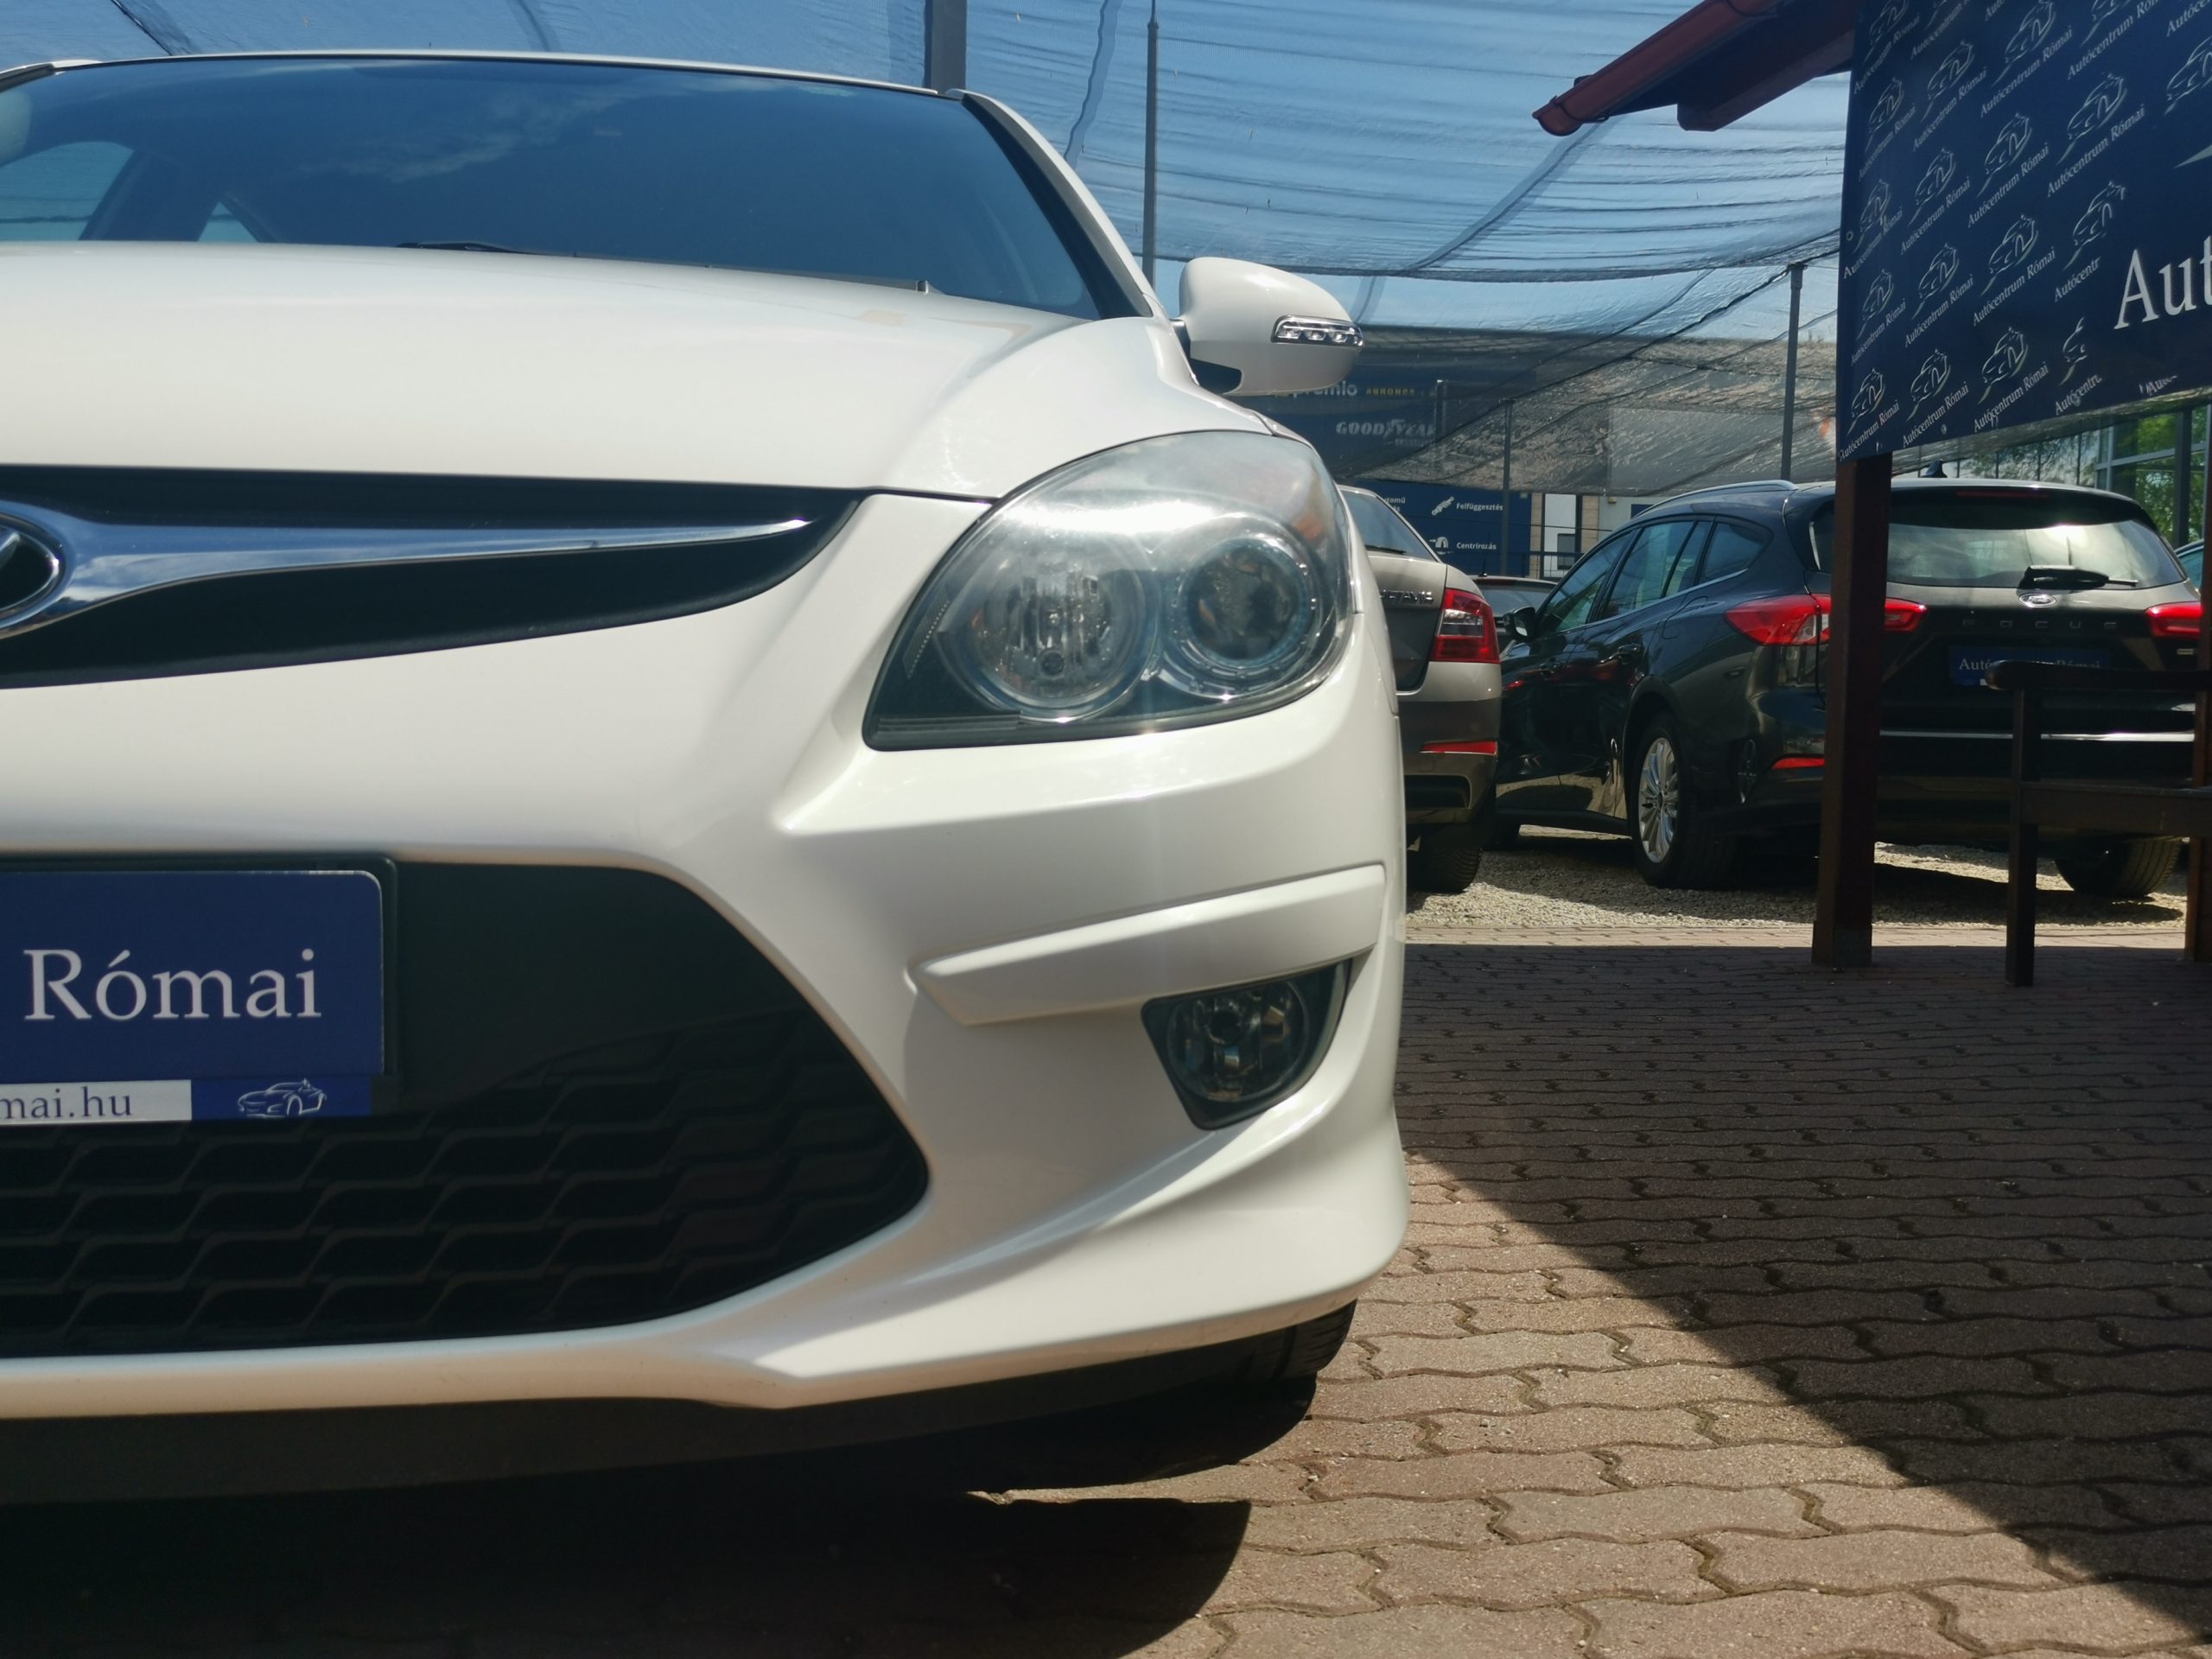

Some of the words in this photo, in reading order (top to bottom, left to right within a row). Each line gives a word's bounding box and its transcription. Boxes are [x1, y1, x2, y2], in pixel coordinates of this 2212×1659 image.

[1980, 60, 2041, 118] Autócentrum
[2043, 25, 2072, 62] Római
[2068, 15, 2134, 80] Autócentrum
[1967, 173, 2020, 228] Autócentrum
[2020, 142, 2050, 176] Római
[2047, 137, 2109, 197] Autócentrum
[2110, 104, 2145, 141] Római
[1901, 205, 1945, 255] Autócentrum
[1946, 175, 1971, 208] Római
[1904, 300, 1949, 347] Autócentrum
[1949, 273, 1974, 304] Római
[1973, 275, 2025, 327] Autócentrum
[2026, 245, 2056, 279] Római
[1839, 422, 1879, 461] Autócentrum
[1878, 398, 1900, 426] Római
[1902, 405, 1946, 448] Autócentrum
[1945, 381, 1969, 410] Római
[1974, 387, 2024, 433] Autócentrum
[2023, 360, 2050, 391] Római
[1456, 502, 1503, 512] Felfüggesztés
[23, 948, 322, 1021] Római
